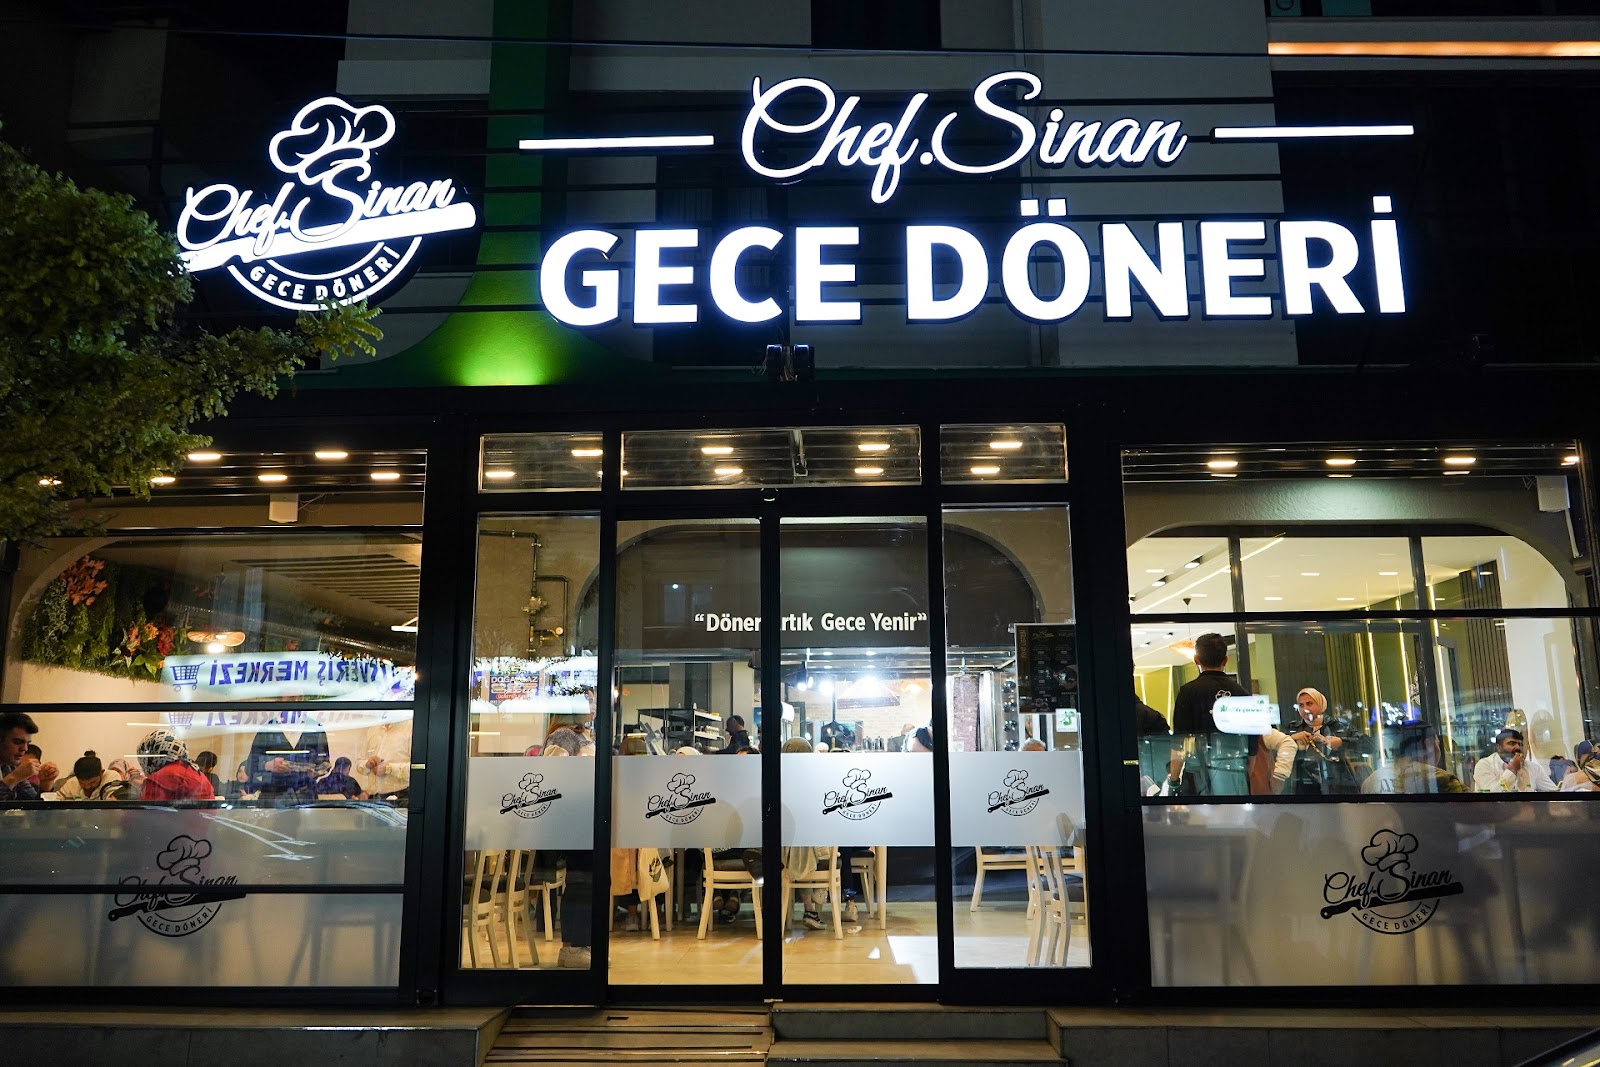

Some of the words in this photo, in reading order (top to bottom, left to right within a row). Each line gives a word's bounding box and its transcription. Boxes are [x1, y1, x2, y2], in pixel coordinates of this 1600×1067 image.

[540, 226, 861, 326] GECE
[906, 195, 1406, 320] DÖNERİ
[249, 265, 306, 300] GECE
[780, 612, 814, 631] rtık
[821, 612, 866, 632] Gece
[146, 915, 171, 932] GECE
[1362, 913, 1389, 930] GECE
